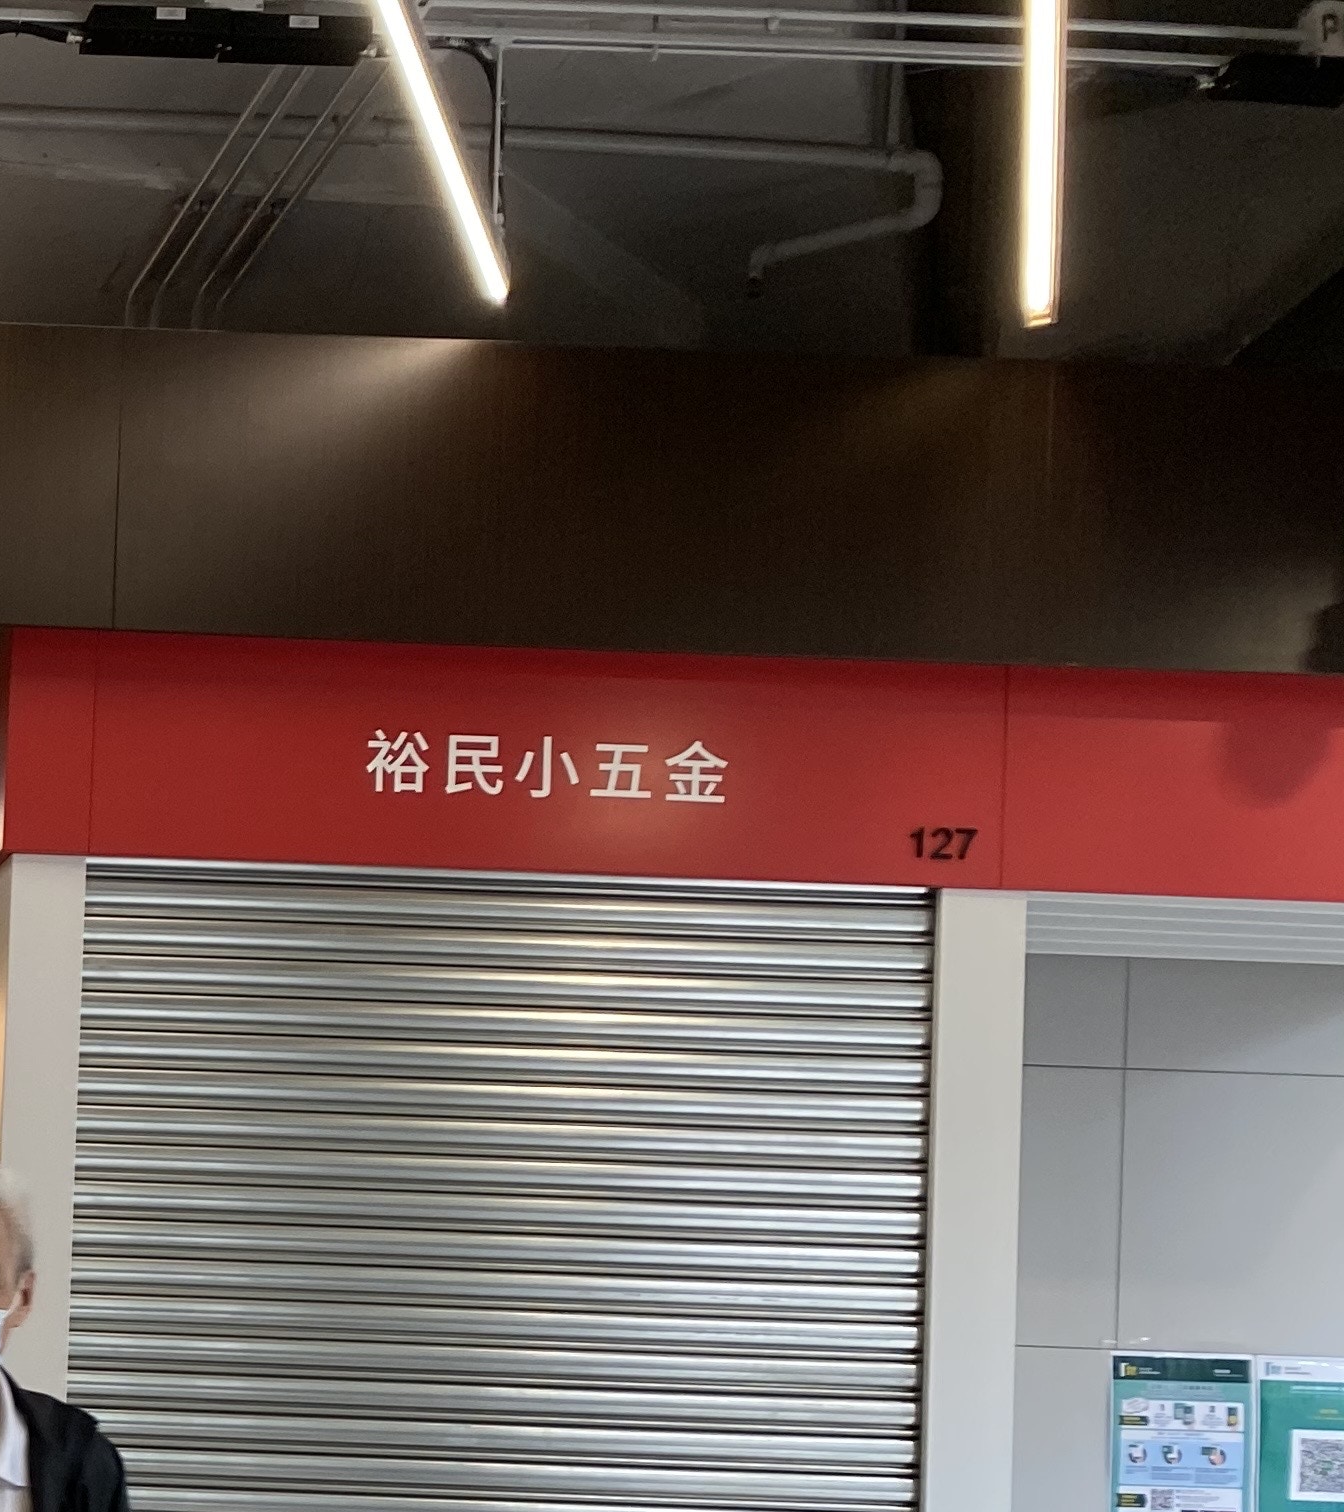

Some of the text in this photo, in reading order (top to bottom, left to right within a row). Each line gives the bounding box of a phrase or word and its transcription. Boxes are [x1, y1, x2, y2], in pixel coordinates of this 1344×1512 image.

[367, 730, 728, 804] 裕民小五金
[909, 826, 978, 861] 127
